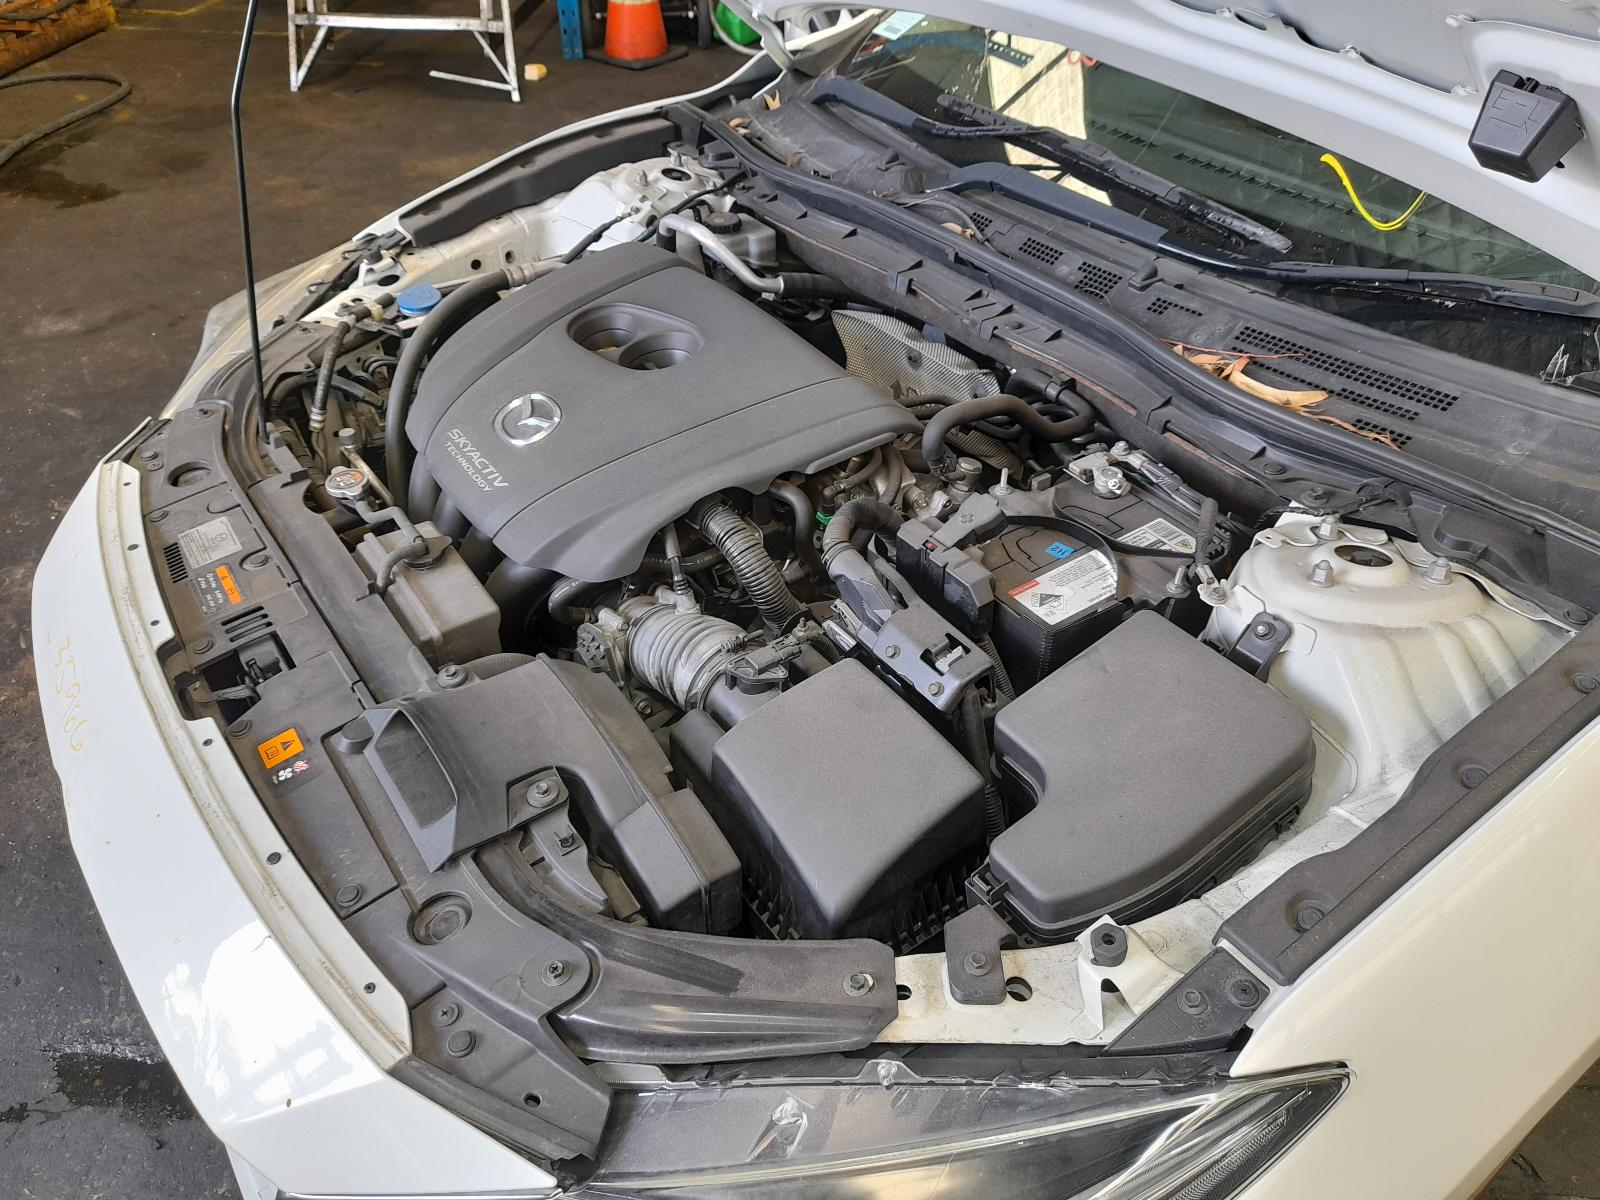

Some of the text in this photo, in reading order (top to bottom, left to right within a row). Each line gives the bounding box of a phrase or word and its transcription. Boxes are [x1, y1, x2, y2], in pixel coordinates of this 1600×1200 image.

[444, 440, 493, 492] TECHNOLOGY
[447, 428, 510, 487] SKYACTIV
[1050, 545, 1068, 556] H2
